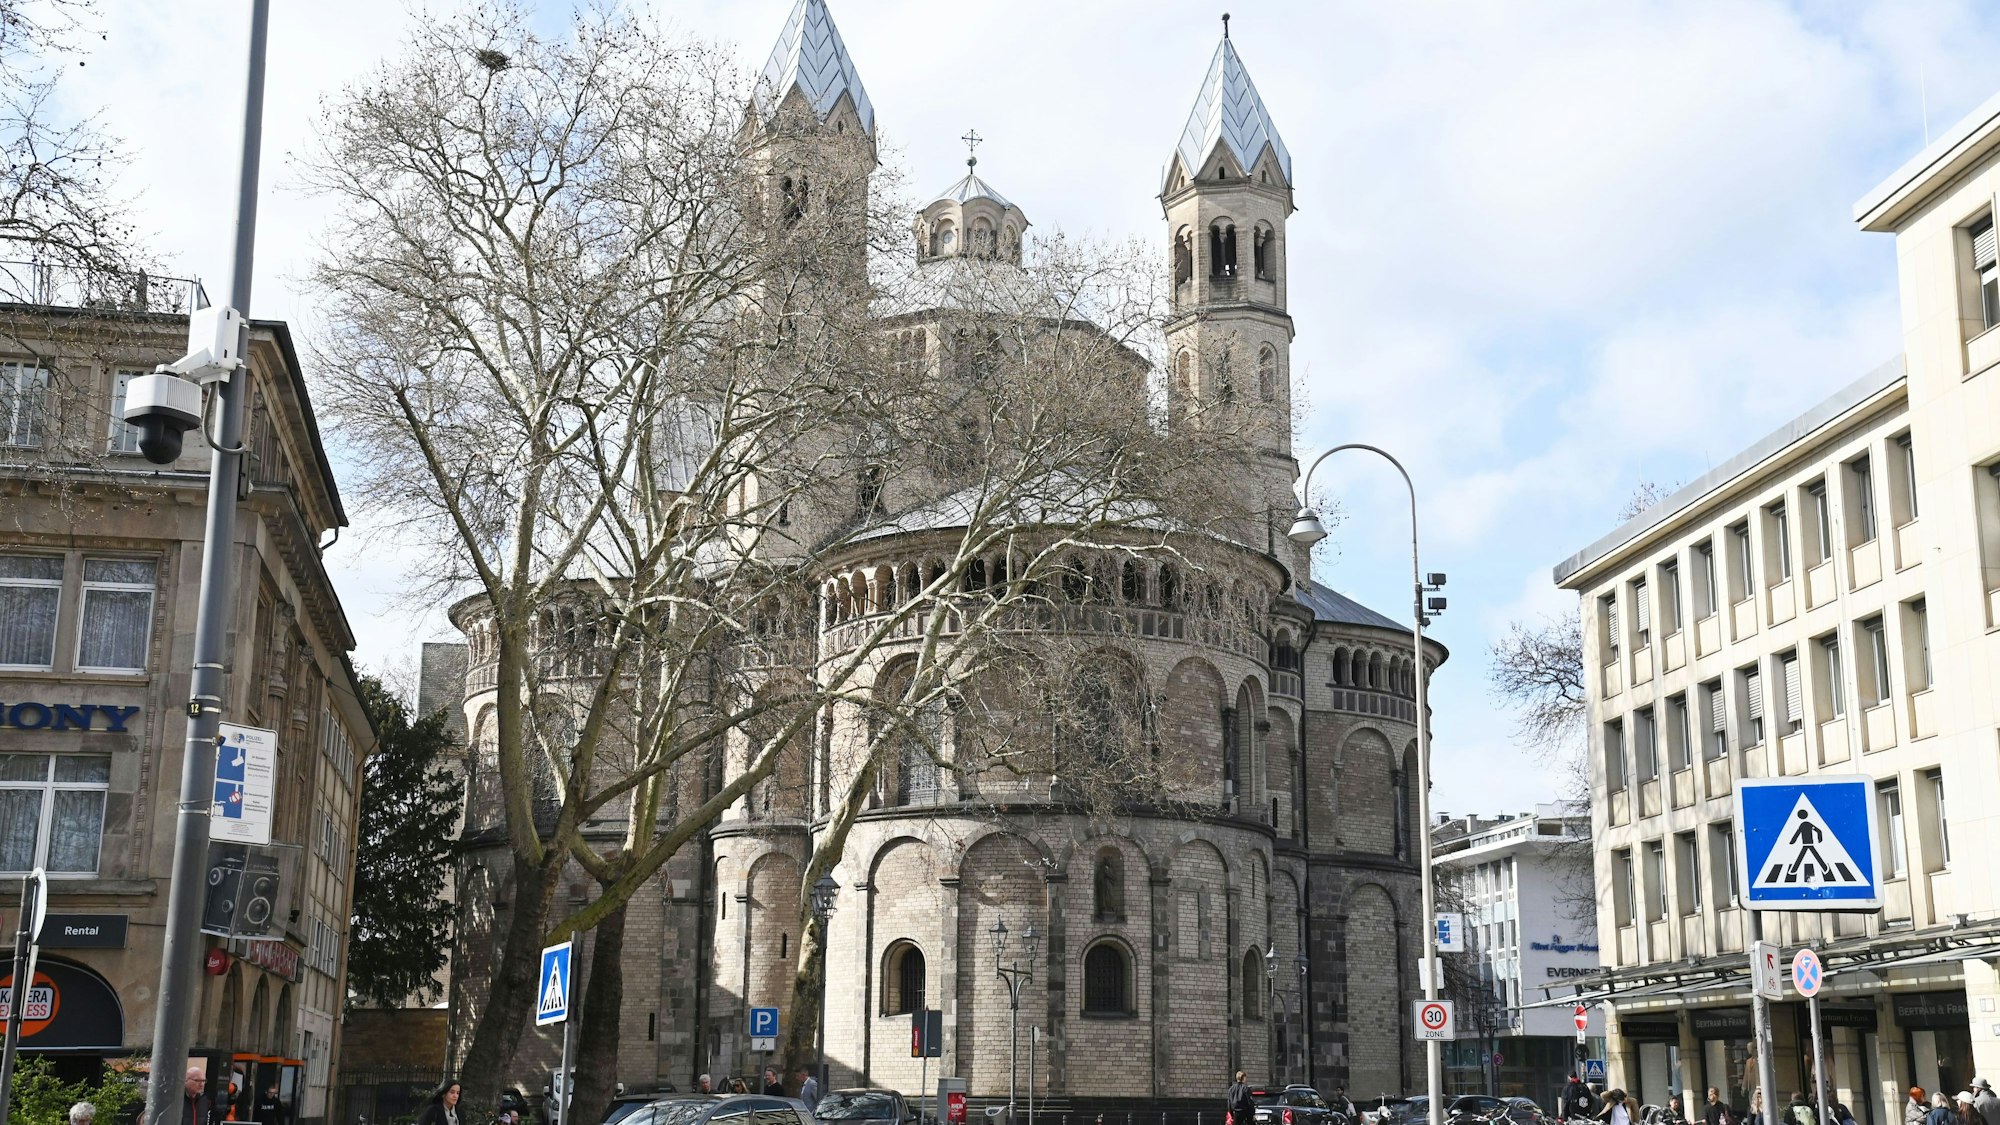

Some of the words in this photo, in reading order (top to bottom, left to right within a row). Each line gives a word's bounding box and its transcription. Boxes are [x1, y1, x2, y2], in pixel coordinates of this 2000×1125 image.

[190, 703, 200, 714] 12
[0, 702, 140, 732] ONY
[64, 926, 99, 936] Rental
[0, 990, 48, 1003] KERA
[1946, 1003, 1968, 1014] FRAN
[756, 1011, 772, 1033] P
[1426, 1010, 1442, 1023] 30
